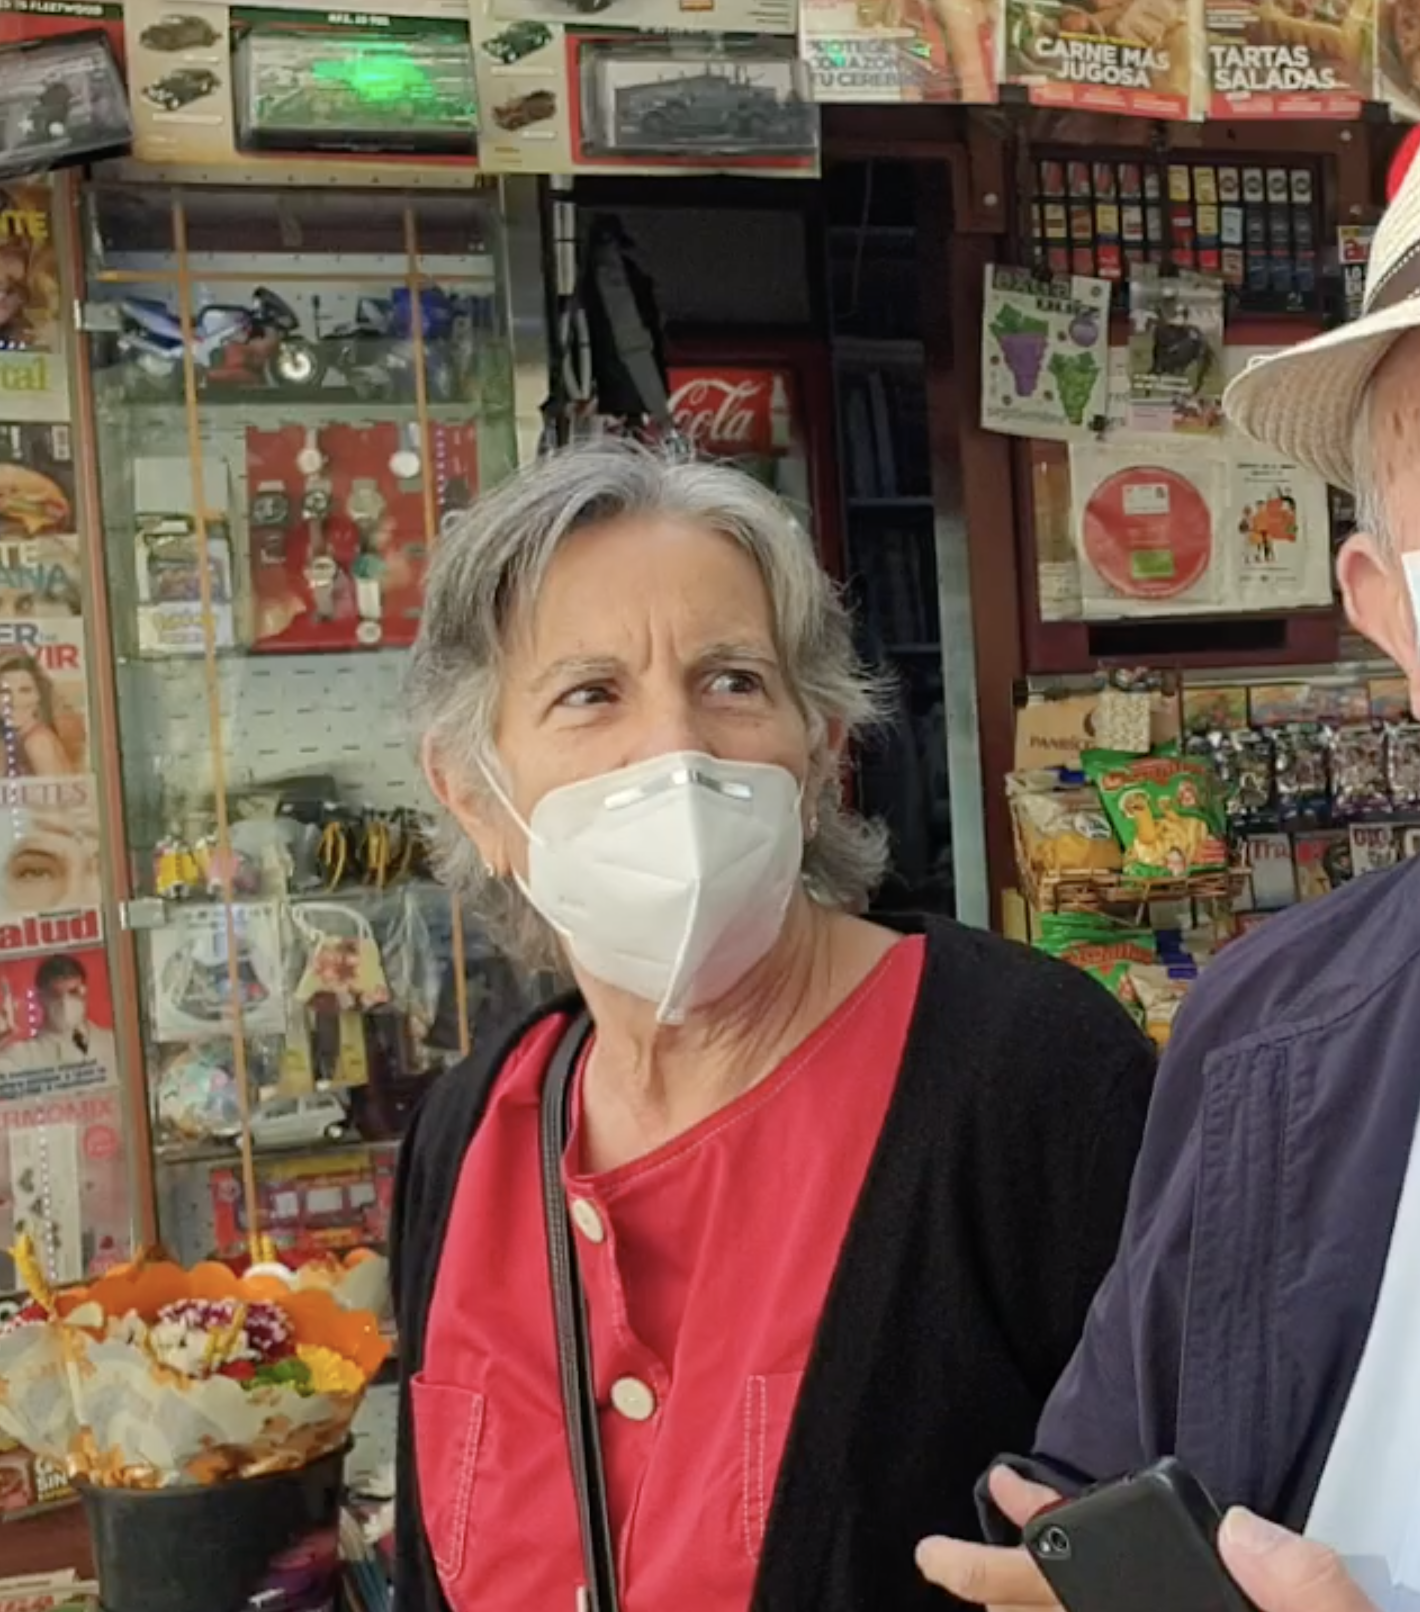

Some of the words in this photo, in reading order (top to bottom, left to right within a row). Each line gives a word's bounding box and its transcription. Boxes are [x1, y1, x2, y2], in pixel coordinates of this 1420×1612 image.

[1034, 38, 1118, 65] CARNE
[1209, 45, 1311, 68] TARTAS
[1057, 60, 1152, 89] JUGOSA
